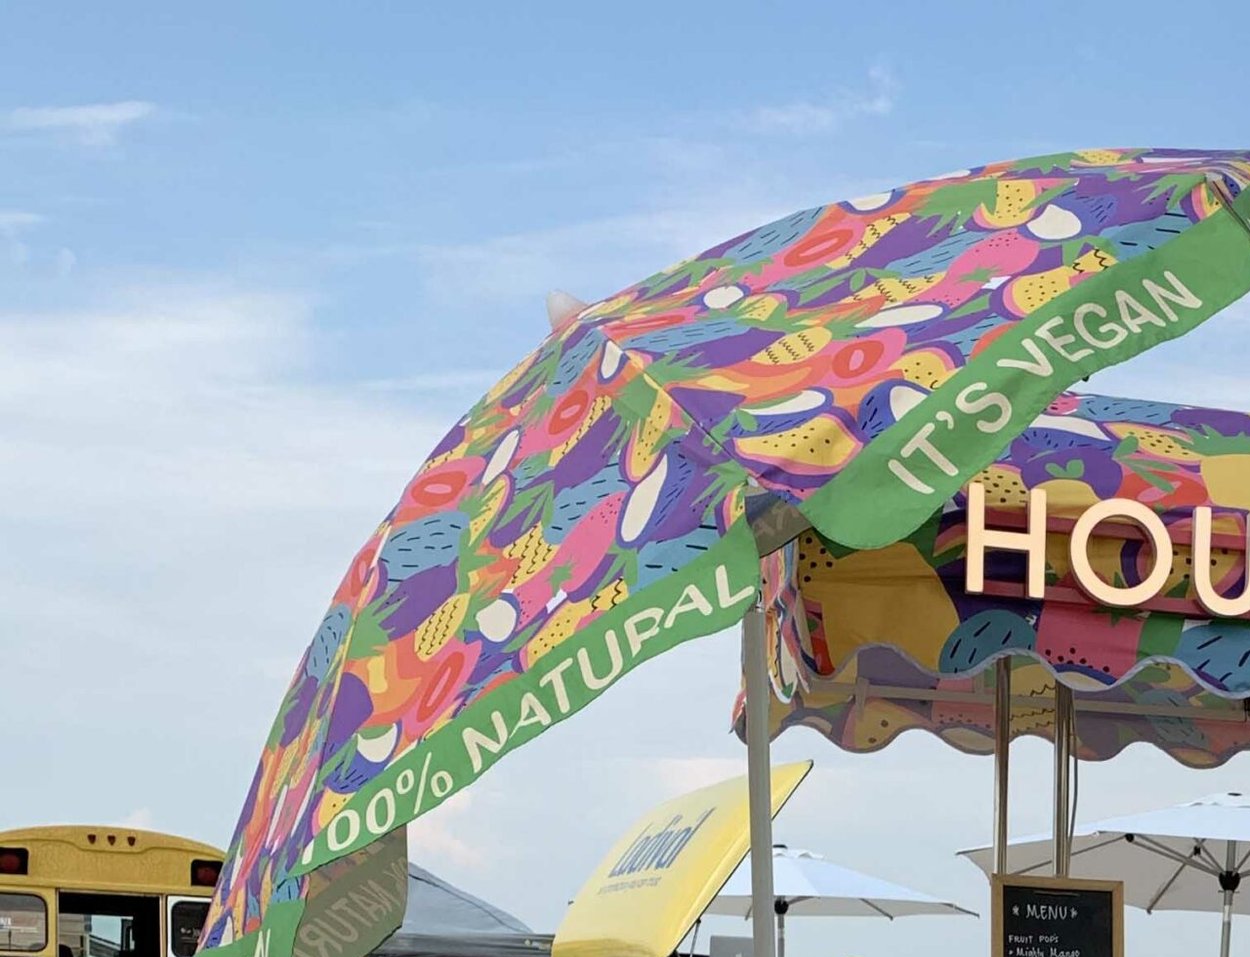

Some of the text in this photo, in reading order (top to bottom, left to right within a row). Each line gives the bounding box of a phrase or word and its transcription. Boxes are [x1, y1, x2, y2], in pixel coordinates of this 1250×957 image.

[888, 270, 1203, 495] IT'S VEGAN
[462, 565, 756, 775] NATURAL
[1008, 934, 1033, 943] FRUIT
[1026, 904, 1067, 920] MENU
